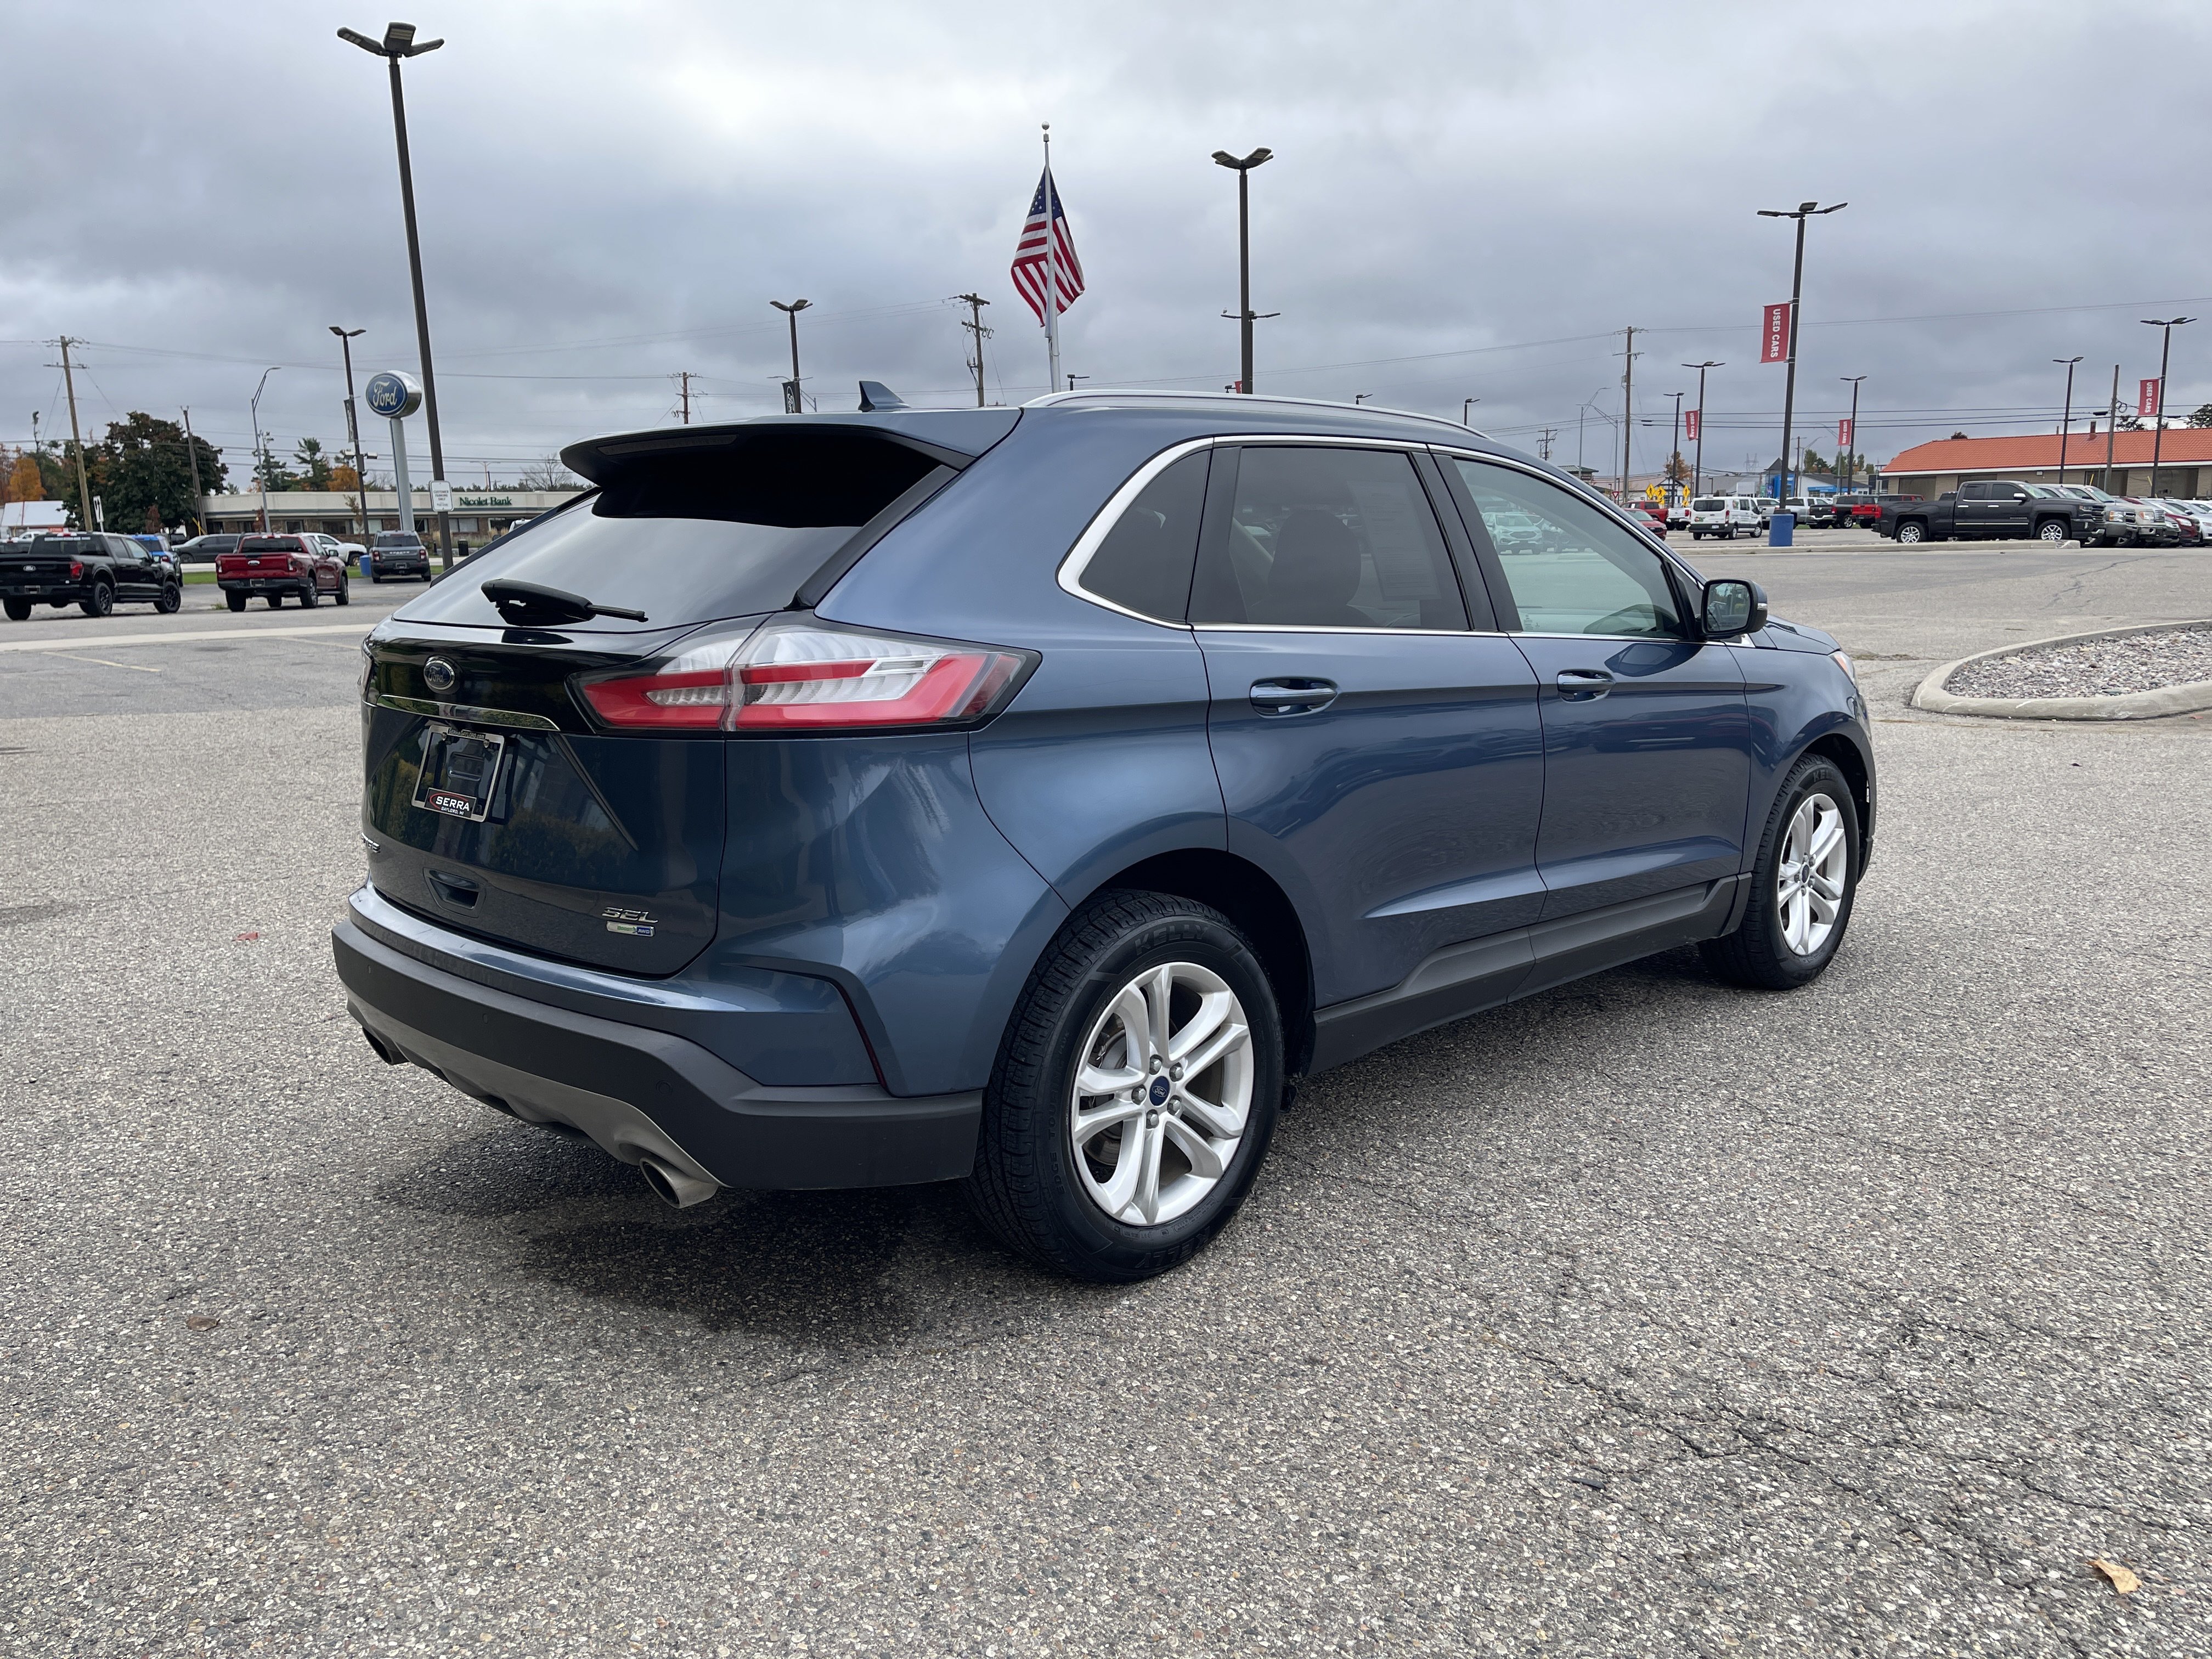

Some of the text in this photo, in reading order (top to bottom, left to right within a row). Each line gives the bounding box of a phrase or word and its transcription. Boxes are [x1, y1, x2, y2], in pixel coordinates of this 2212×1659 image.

[1770, 308, 1781, 358] USED CARS
[373, 381, 397, 407] Ford
[459, 496, 512, 506] Nicolet Bank
[428, 665, 447, 683] Ford
[436, 796, 470, 811] SERRA
[441, 806, 459, 815] GAYLORD,
[602, 907, 658, 923] SEL
[1135, 924, 1208, 956] KELLY
[1049, 1152, 1065, 1195] EDGE
